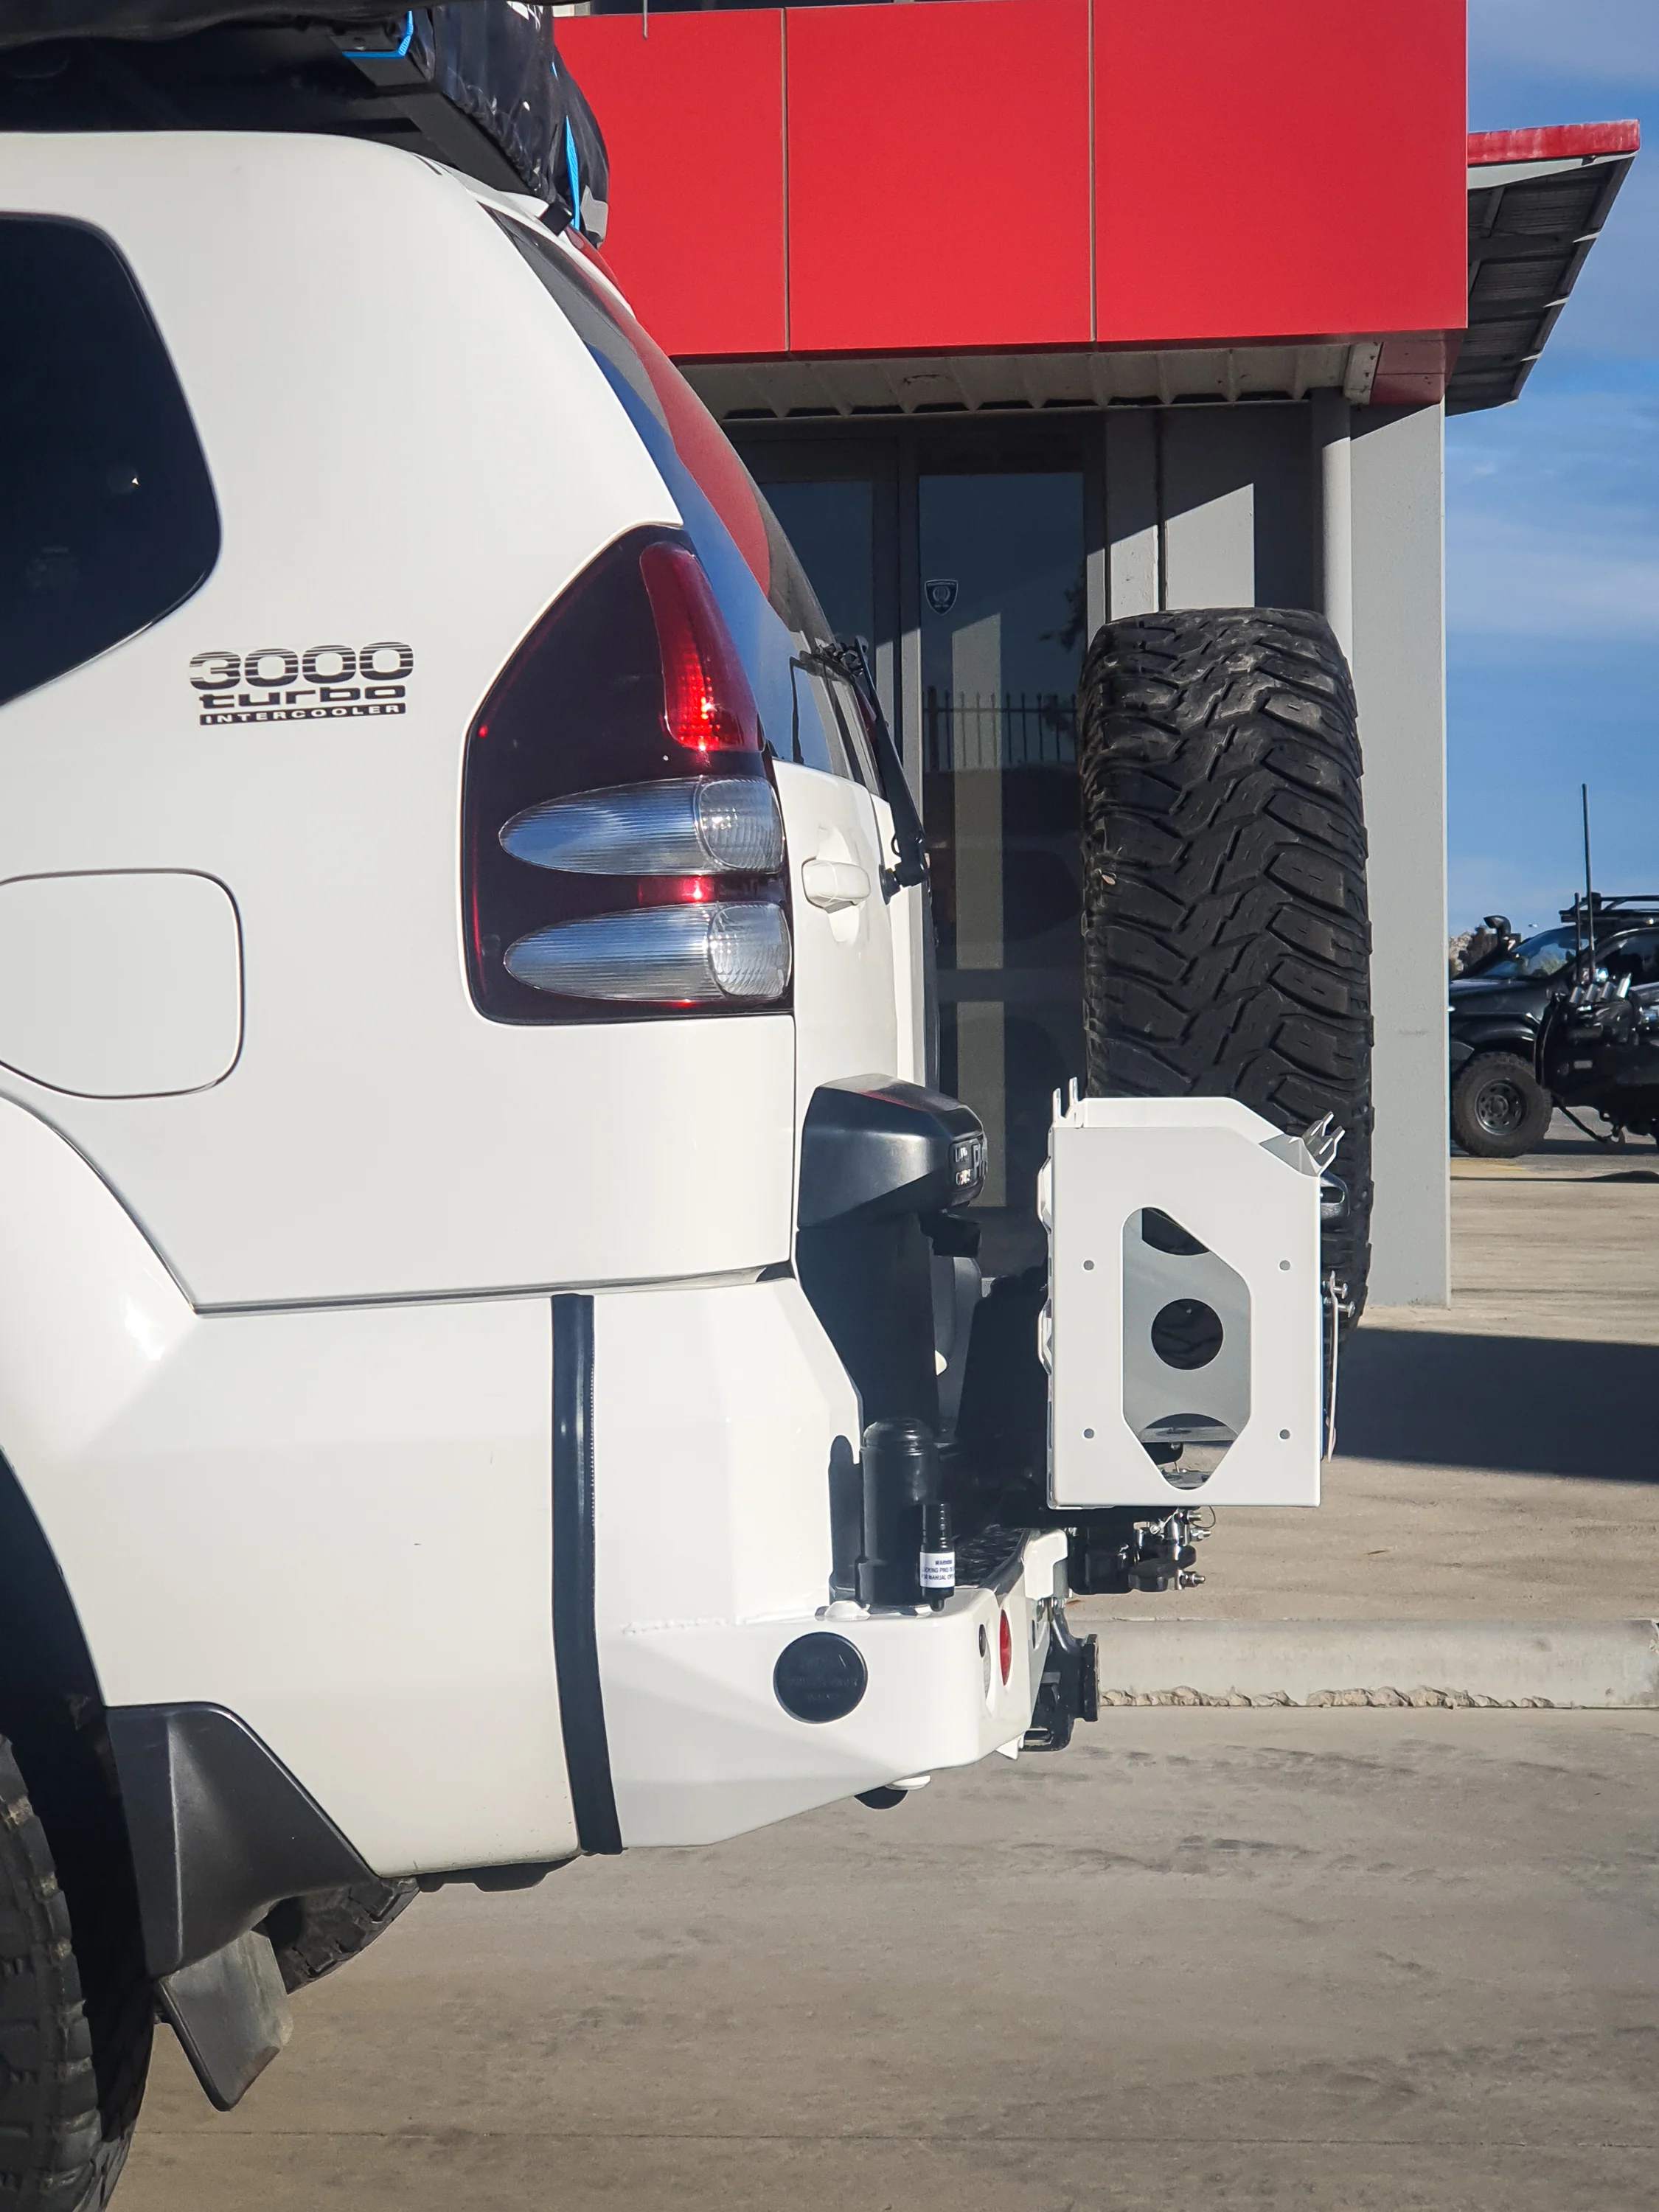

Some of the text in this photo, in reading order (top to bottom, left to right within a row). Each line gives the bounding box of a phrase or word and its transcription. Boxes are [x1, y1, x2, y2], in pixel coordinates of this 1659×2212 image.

[189, 641, 414, 690] 3000
[199, 685, 406, 709] turbo
[205, 704, 400, 724] INTERCOOLER
